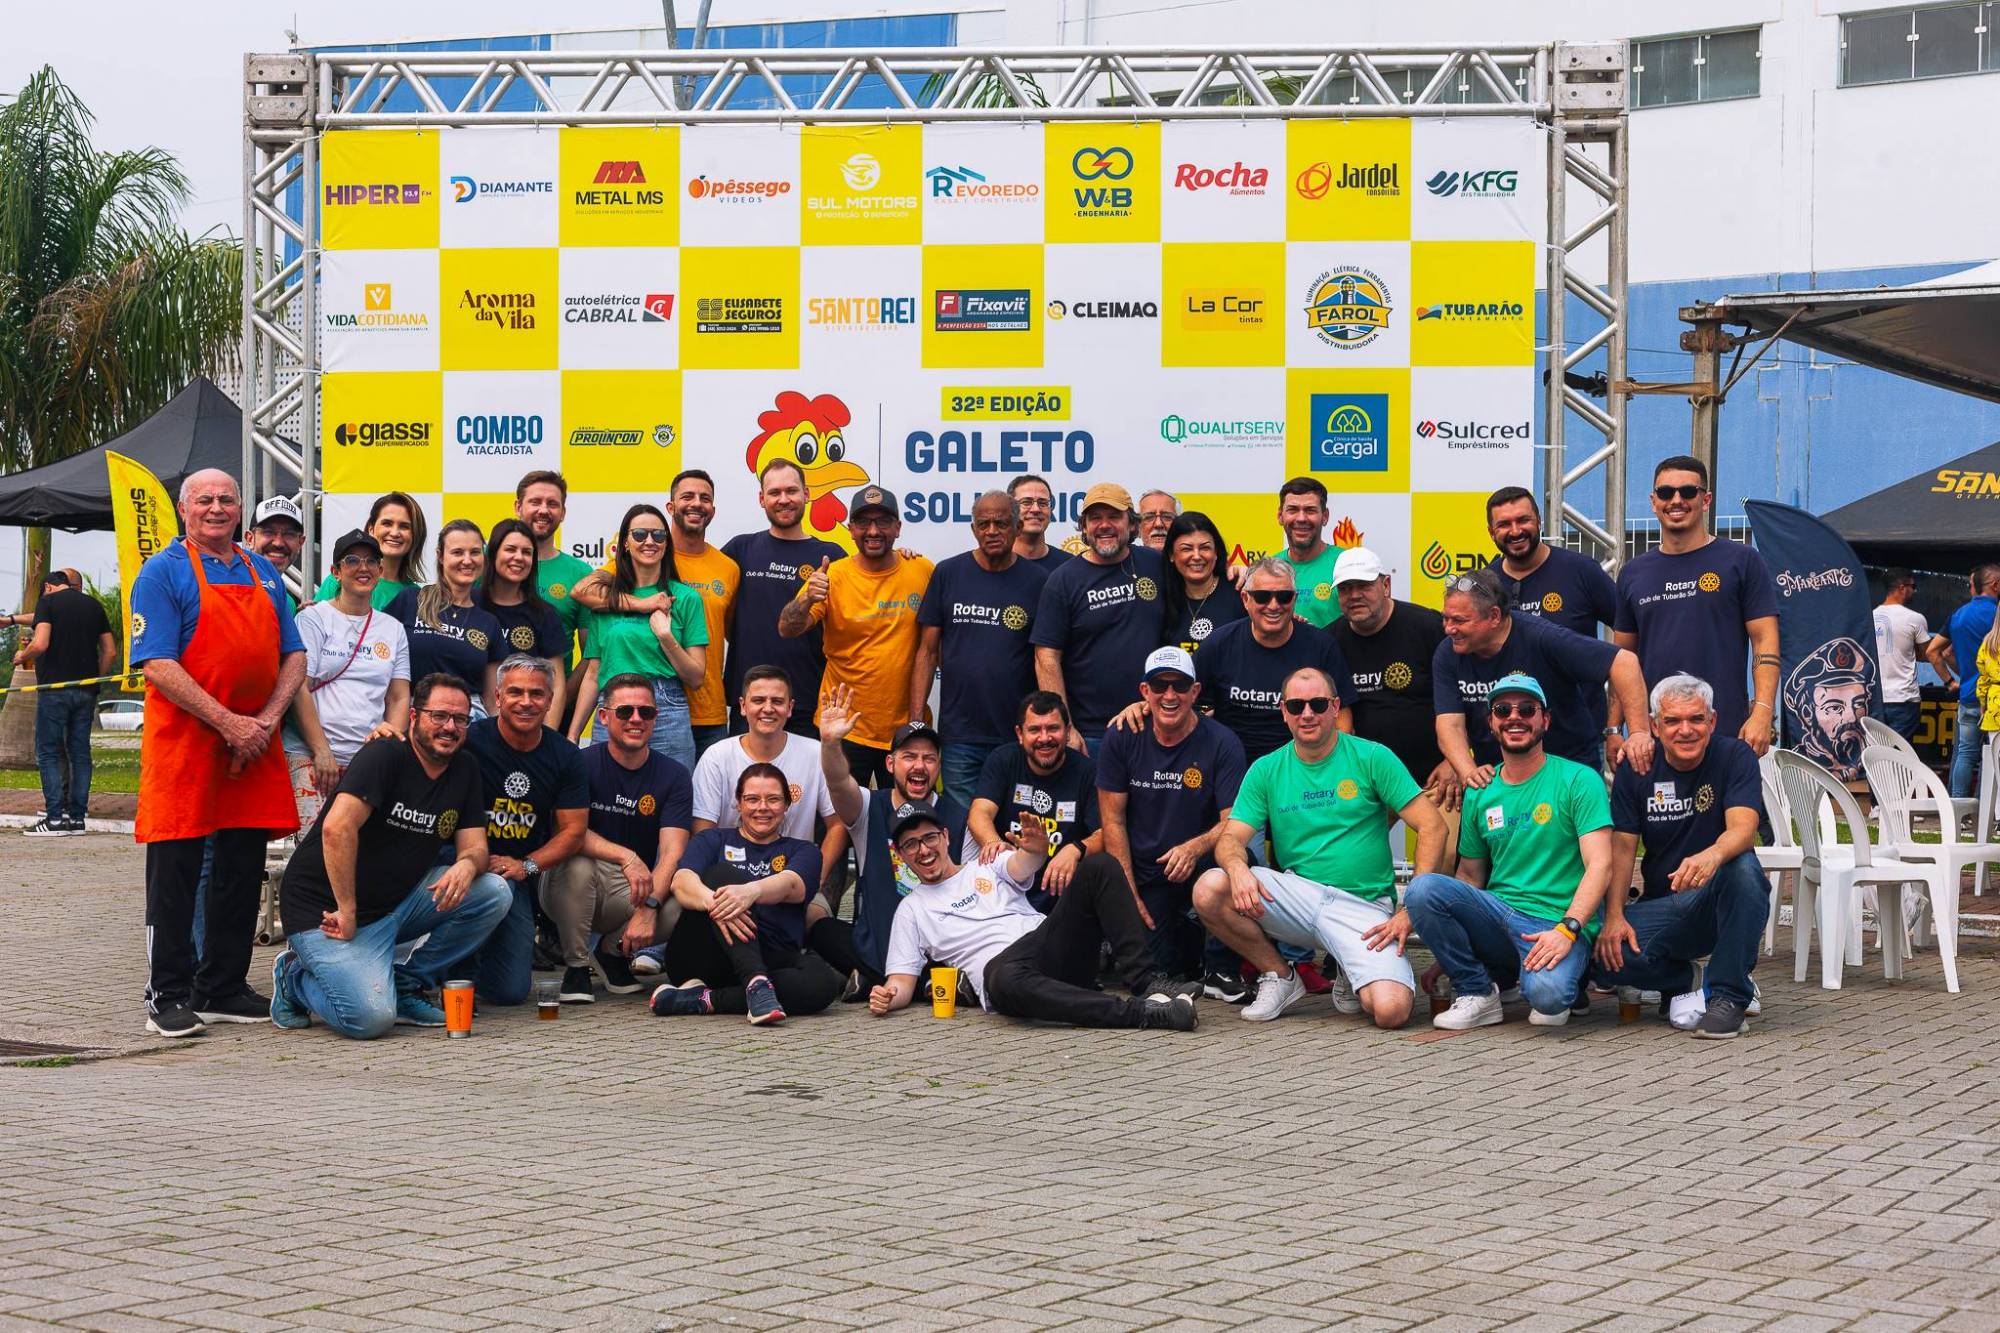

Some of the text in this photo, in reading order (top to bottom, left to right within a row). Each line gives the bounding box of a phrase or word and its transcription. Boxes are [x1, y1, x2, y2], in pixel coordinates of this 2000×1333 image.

[1174, 161, 1269, 191] Rocha
[1336, 163, 1400, 189] Jardel
[1462, 170, 1518, 192] KFG
[325, 184, 400, 205] HIPER
[479, 182, 553, 194] DIAMANTE
[711, 176, 791, 197] pêssego
[1230, 187, 1266, 196] Alimentos
[576, 191, 664, 205] METAL MS
[807, 196, 918, 209] SUL MOTORS
[1074, 187, 1133, 208] W&B
[1333, 265, 1360, 275] ELÉTRICA
[460, 289, 536, 310] Aroma
[565, 294, 641, 306] autoelétrica
[724, 298, 782, 308] ELISABETE
[966, 297, 1026, 312] Fixavit
[1187, 295, 1264, 313] La Cor
[565, 308, 638, 323] CABRAL
[724, 309, 782, 320] SEGUROS
[1072, 301, 1158, 318] CLEIMAQ
[1316, 308, 1380, 322] FAROL
[1444, 300, 1524, 316] TUBARÃO
[475, 308, 536, 330] da Vila
[1238, 314, 1264, 324] tintas
[1316, 332, 1380, 351] DISTRIBUIDORA
[951, 392, 1061, 415] 32ª EDIÇÃO
[456, 415, 544, 445] COMBO
[1188, 421, 1285, 435] QUALITSERV
[1437, 421, 1530, 439] Sulcred
[375, 439, 430, 447] SUPERMERCADOS
[466, 445, 534, 455] ATACADISTA
[1321, 438, 1378, 460] Cergal
[1448, 441, 1510, 450] Empréstimos
[905, 430, 1095, 474] GALETO
[572, 536, 604, 559] sul
[768, 561, 798, 574] Rotary
[1087, 583, 1134, 604] Rotary
[1665, 580, 1697, 592] Rotary
[1639, 596, 1652, 605] Club
[1662, 591, 1687, 600] Tubarão
[1687, 589, 1697, 597] Sul
[953, 602, 1001, 620] Rotary
[1230, 686, 1282, 705] Rotary
[1154, 770, 1183, 783] Rotary
[1303, 788, 1336, 800] Rotary
[494, 797, 534, 815] END
[391, 802, 437, 828] Rotary
[485, 811, 537, 828] POLIO
[487, 824, 531, 839] NOW
